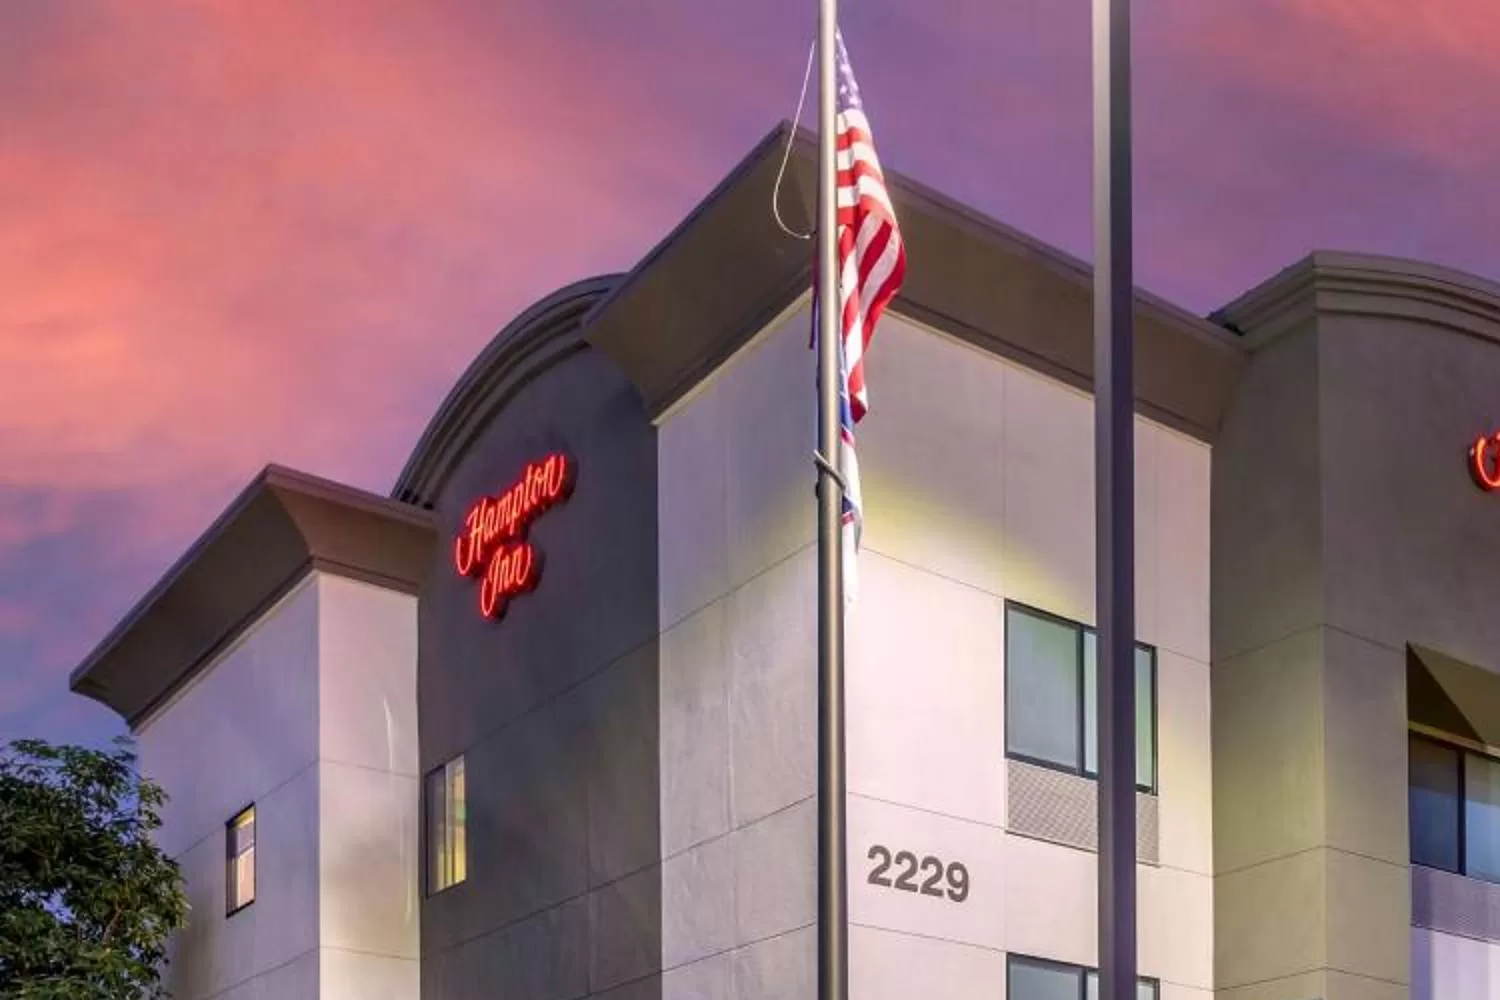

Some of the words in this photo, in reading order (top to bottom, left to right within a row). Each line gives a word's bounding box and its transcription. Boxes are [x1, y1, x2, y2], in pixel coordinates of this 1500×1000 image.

[455, 453, 567, 577] Hampton
[480, 544, 534, 618] Inn
[866, 844, 969, 903] 2229
